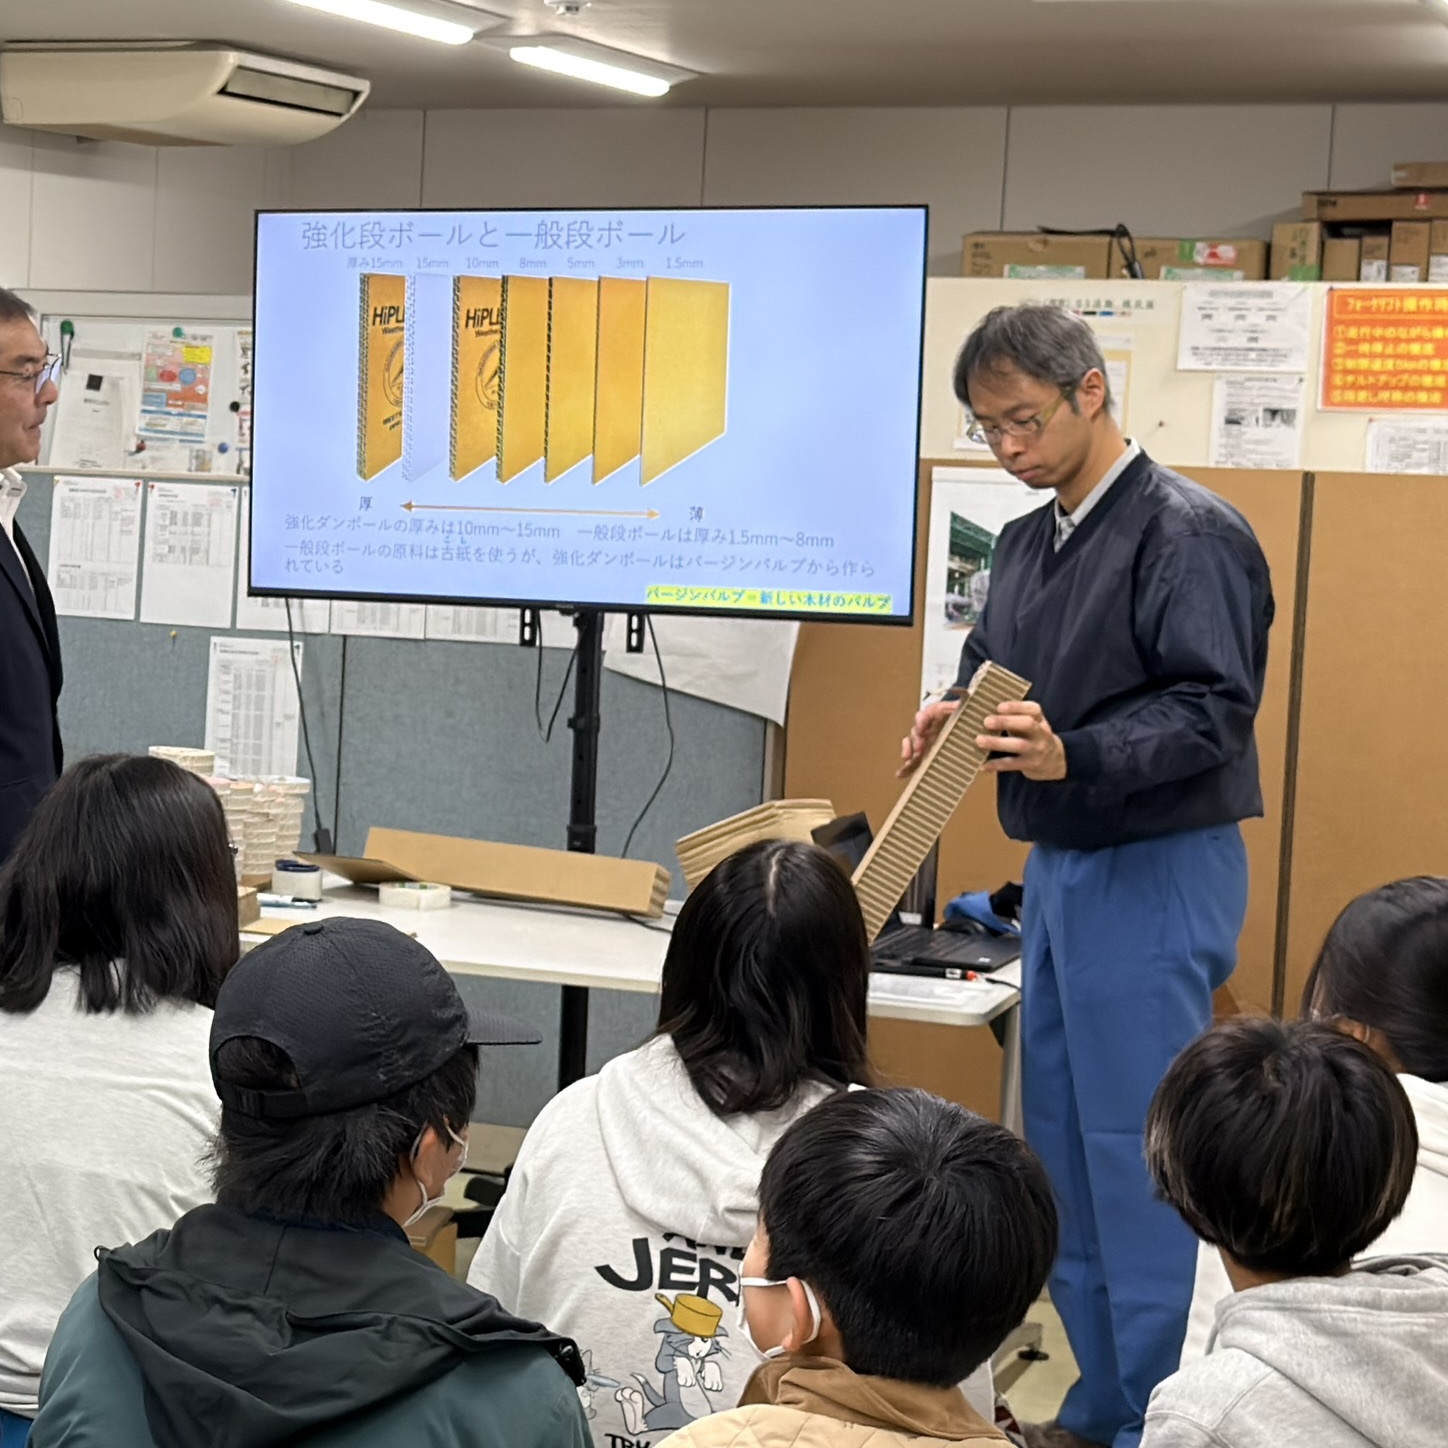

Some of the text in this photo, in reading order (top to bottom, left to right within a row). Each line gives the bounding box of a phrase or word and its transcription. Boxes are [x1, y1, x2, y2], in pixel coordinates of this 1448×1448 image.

[301, 220, 686, 251] 強化段ボールと一般段ボール
[416, 257, 449, 270] 15mm
[465, 257, 499, 270] 10mm
[519, 257, 547, 270] 8mm
[567, 258, 595, 270] 5mm
[616, 258, 645, 270] 3mm
[666, 258, 704, 270] 1.5mm
[359, 496, 373, 511] 厚
[689, 506, 704, 522] 薄
[284, 557, 345, 575] れている
[594, 1237, 739, 1307] JER
